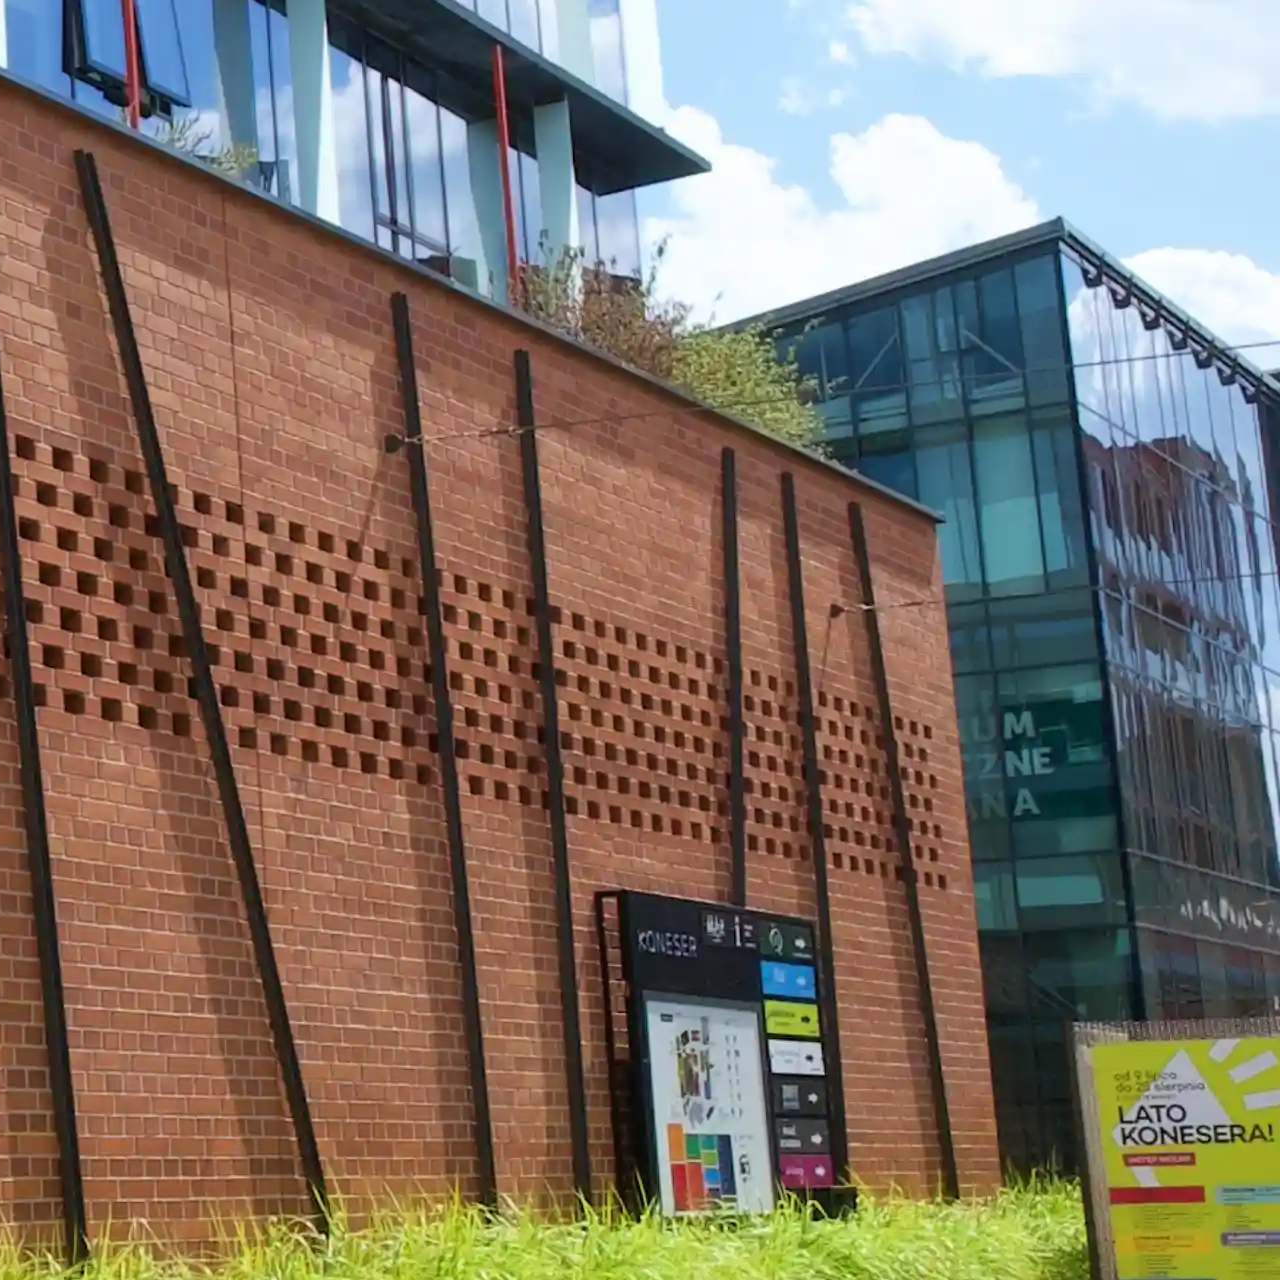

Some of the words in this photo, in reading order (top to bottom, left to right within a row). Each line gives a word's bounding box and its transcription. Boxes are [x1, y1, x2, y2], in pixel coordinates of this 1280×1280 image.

[637, 929, 698, 957] KONESER
[1118, 1104, 1187, 1125] LATO
[1120, 1123, 1276, 1146] KONESERA!
